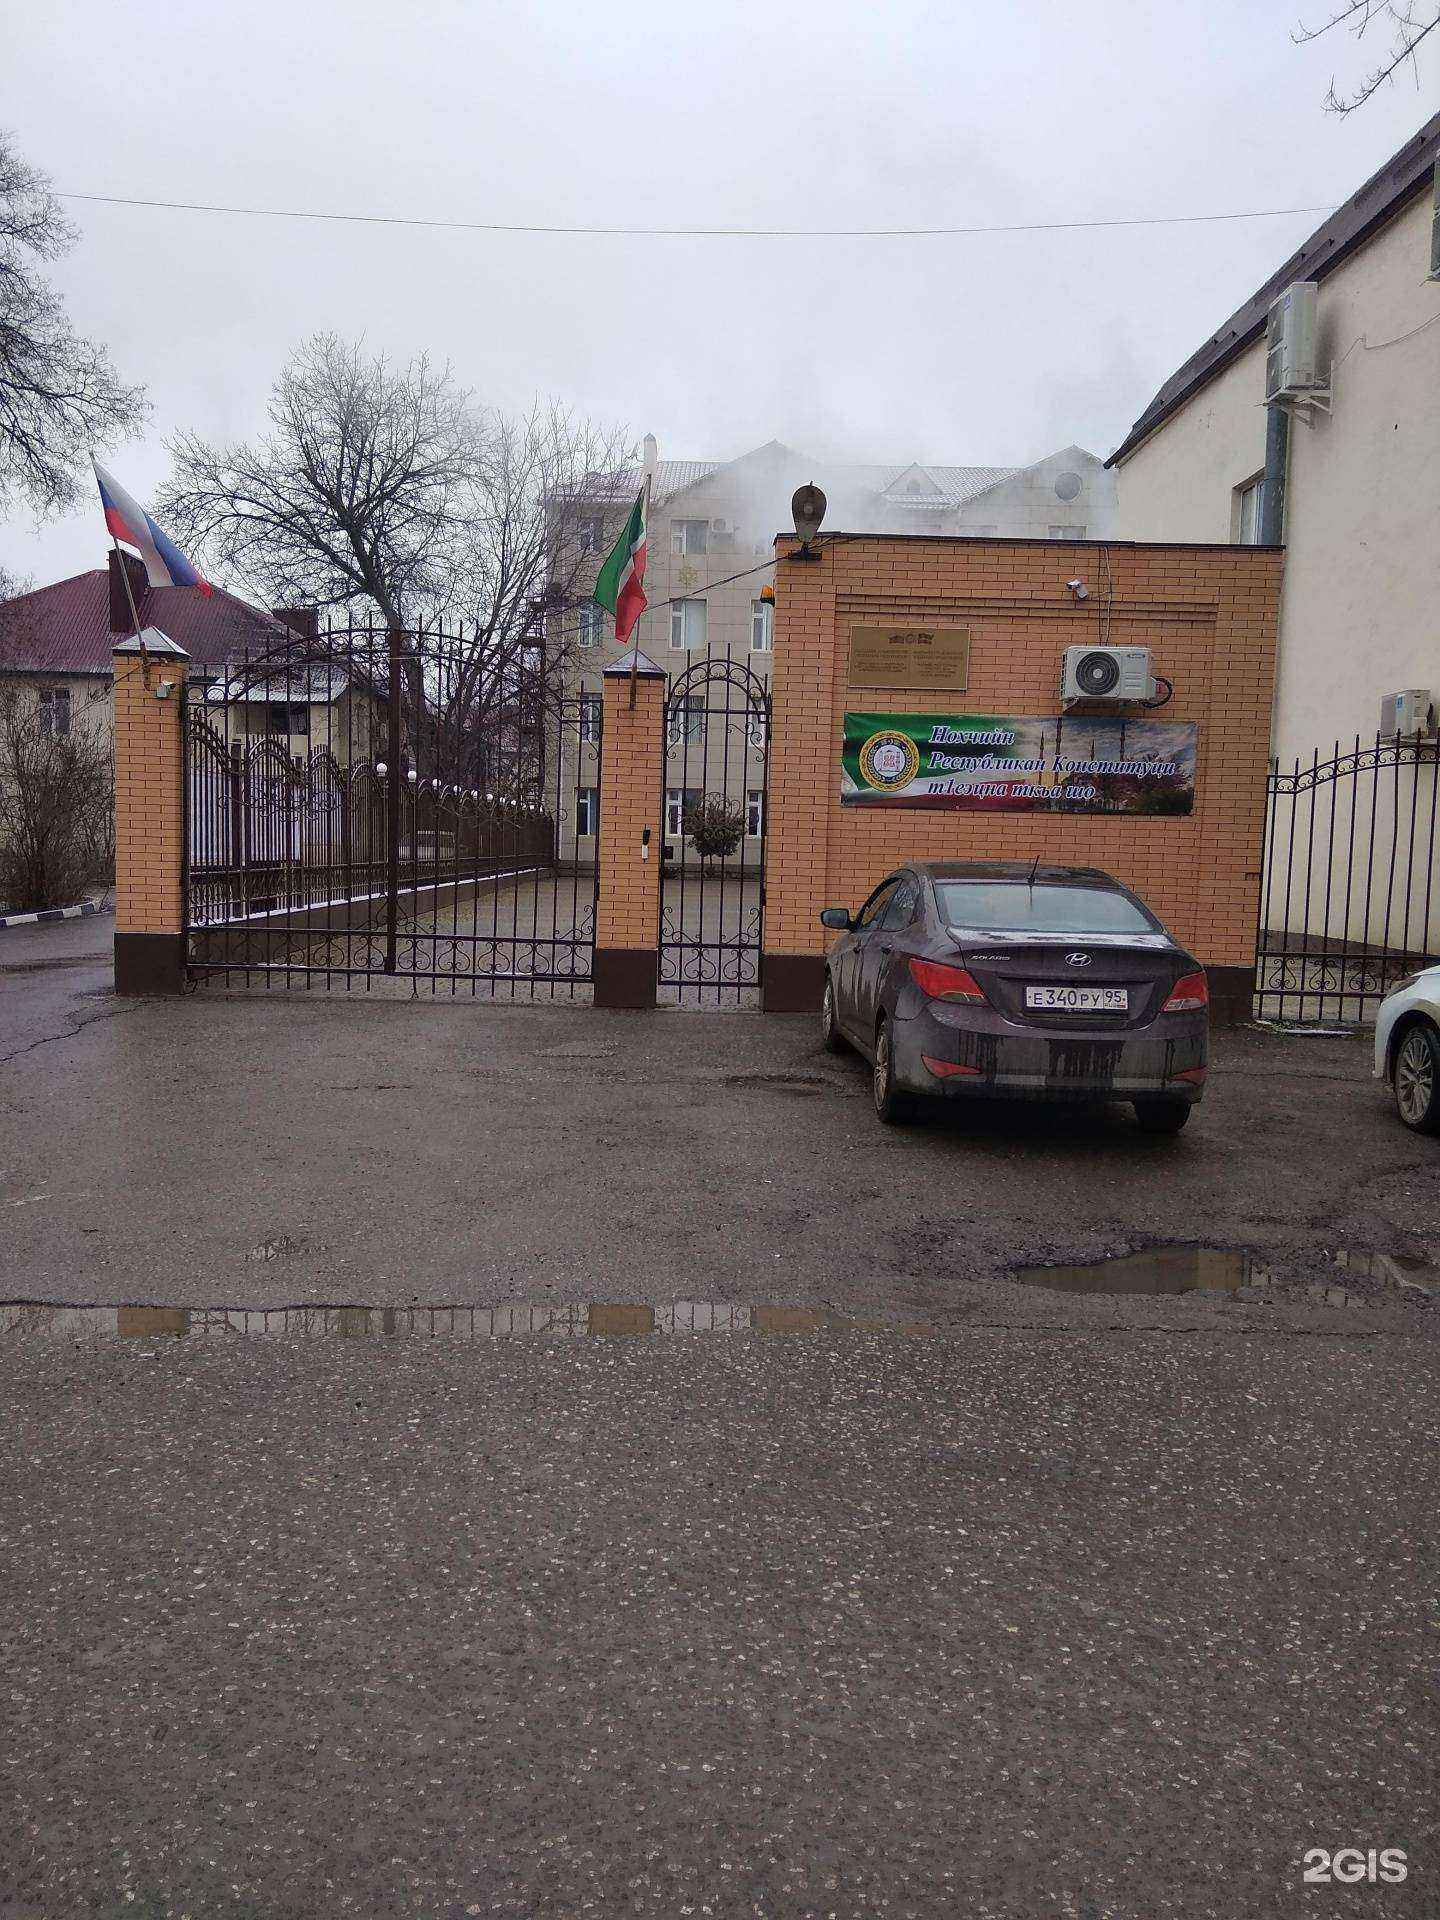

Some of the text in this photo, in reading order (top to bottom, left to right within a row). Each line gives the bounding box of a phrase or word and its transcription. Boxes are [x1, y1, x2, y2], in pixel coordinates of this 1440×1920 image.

[929, 725, 1015, 745] Нохчийн
[927, 751, 1176, 779] Республикан Конституци
[1010, 783, 1062, 798] ткъа
[1066, 785, 1096, 799] шо
